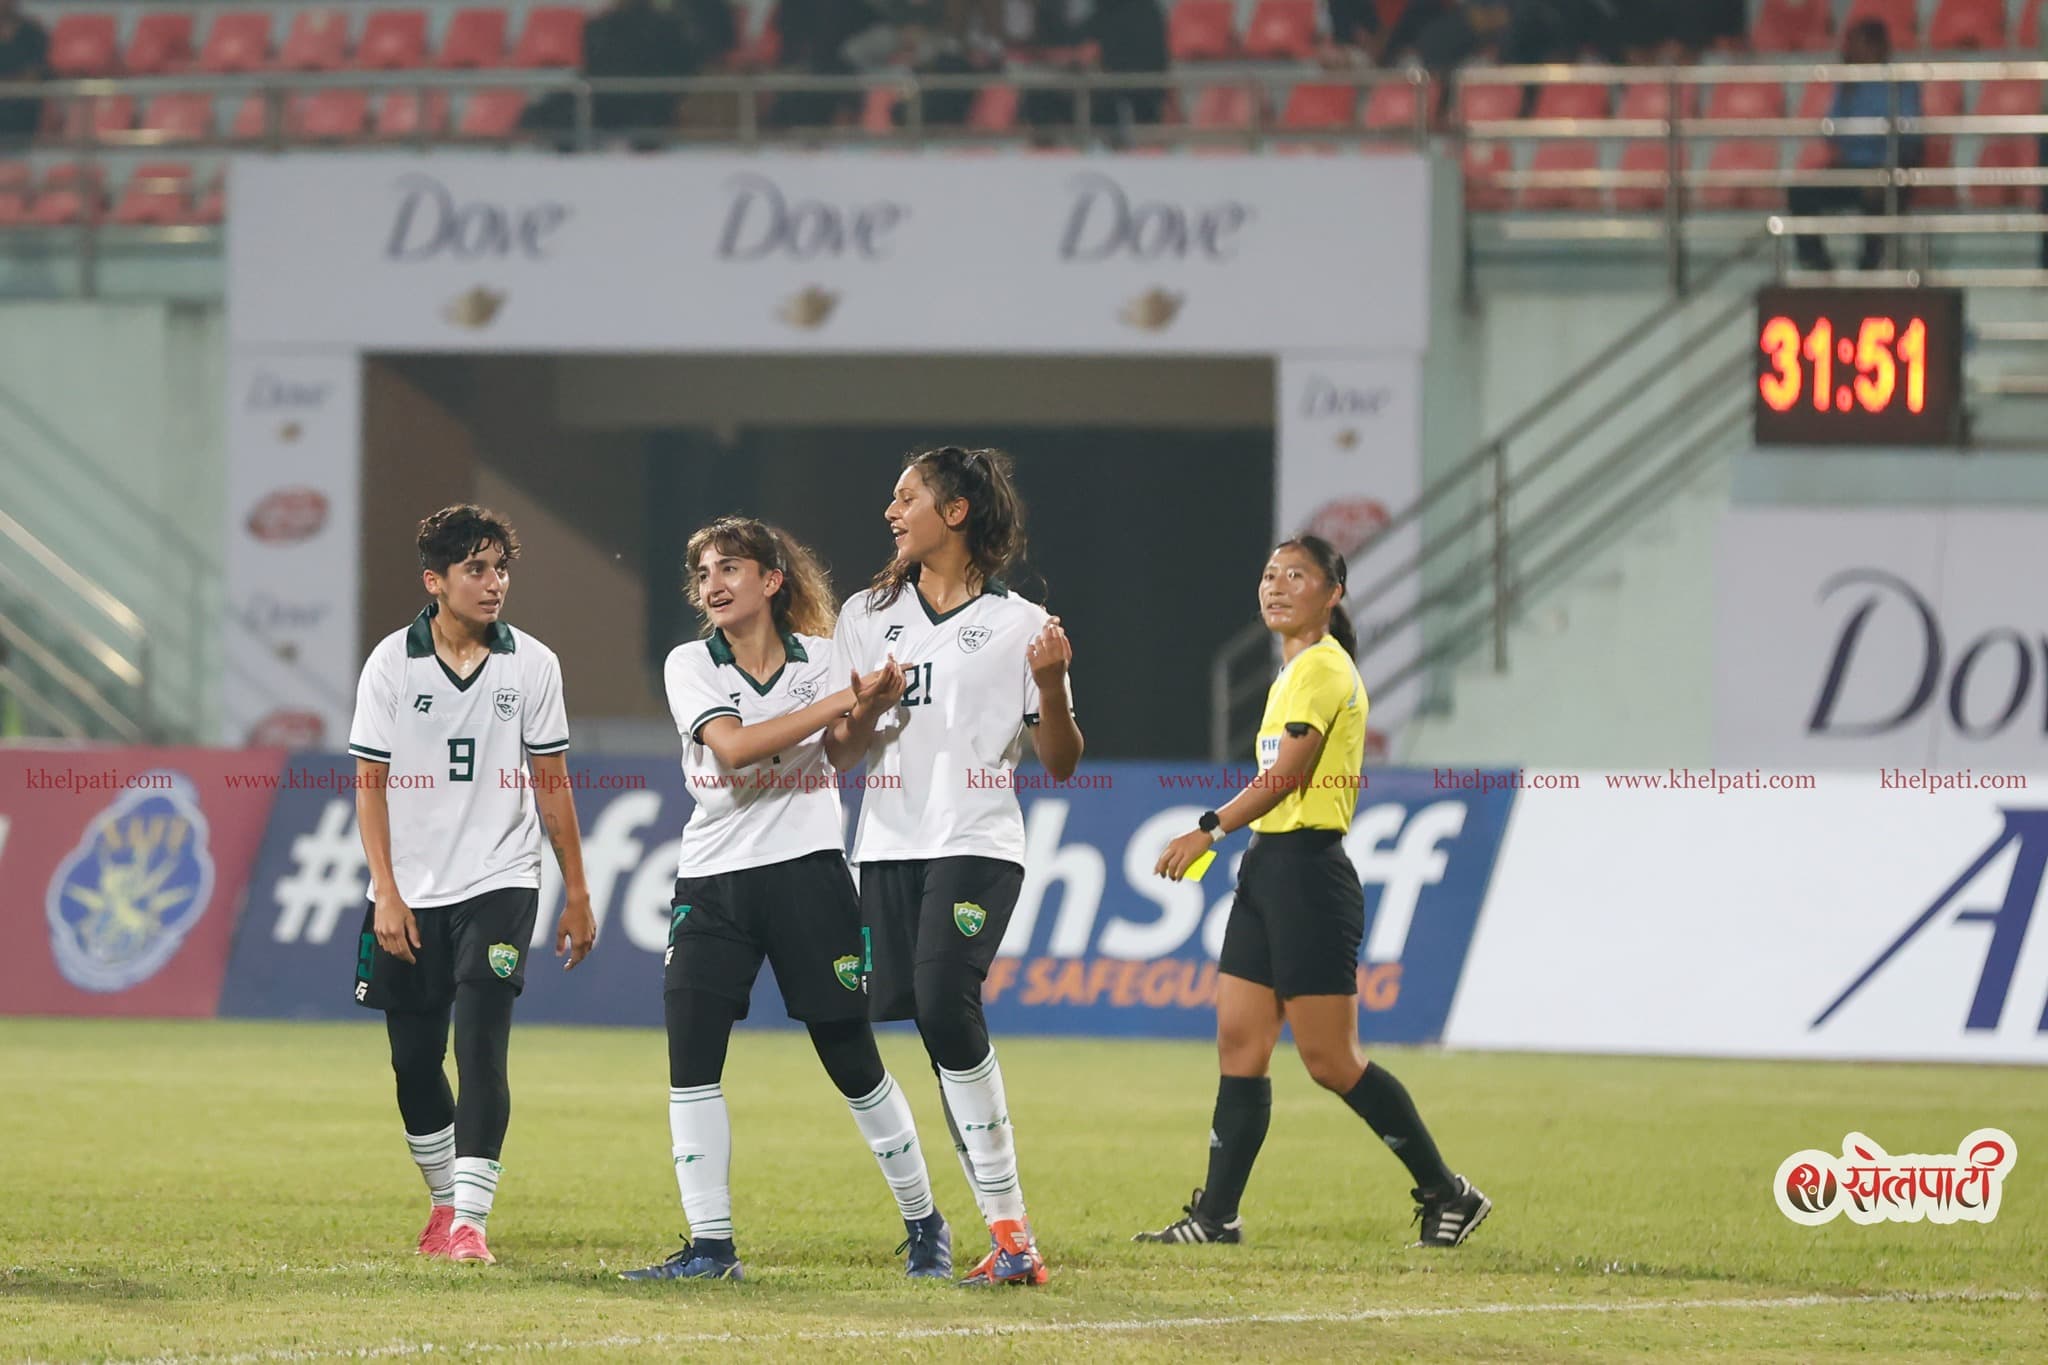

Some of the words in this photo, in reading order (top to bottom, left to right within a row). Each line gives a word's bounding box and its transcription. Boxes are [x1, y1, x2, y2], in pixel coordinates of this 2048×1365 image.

[386, 172, 572, 261] Dove
[717, 171, 908, 262] Dove
[1057, 172, 1254, 262] Dove
[1759, 316, 1927, 413] 31:51
[962, 630, 988, 639] PFF
[1804, 566, 2048, 742] Do
[496, 693, 520, 703] PFF
[899, 661, 932, 707] 21
[447, 738, 475, 781] 9
[1262, 739, 1280, 751] FIF
[957, 907, 983, 920] PFF
[1808, 804, 2048, 1033] A
[492, 949, 516, 961] PFF
[838, 960, 859, 973] PFF
[674, 1154, 705, 1165] FF
